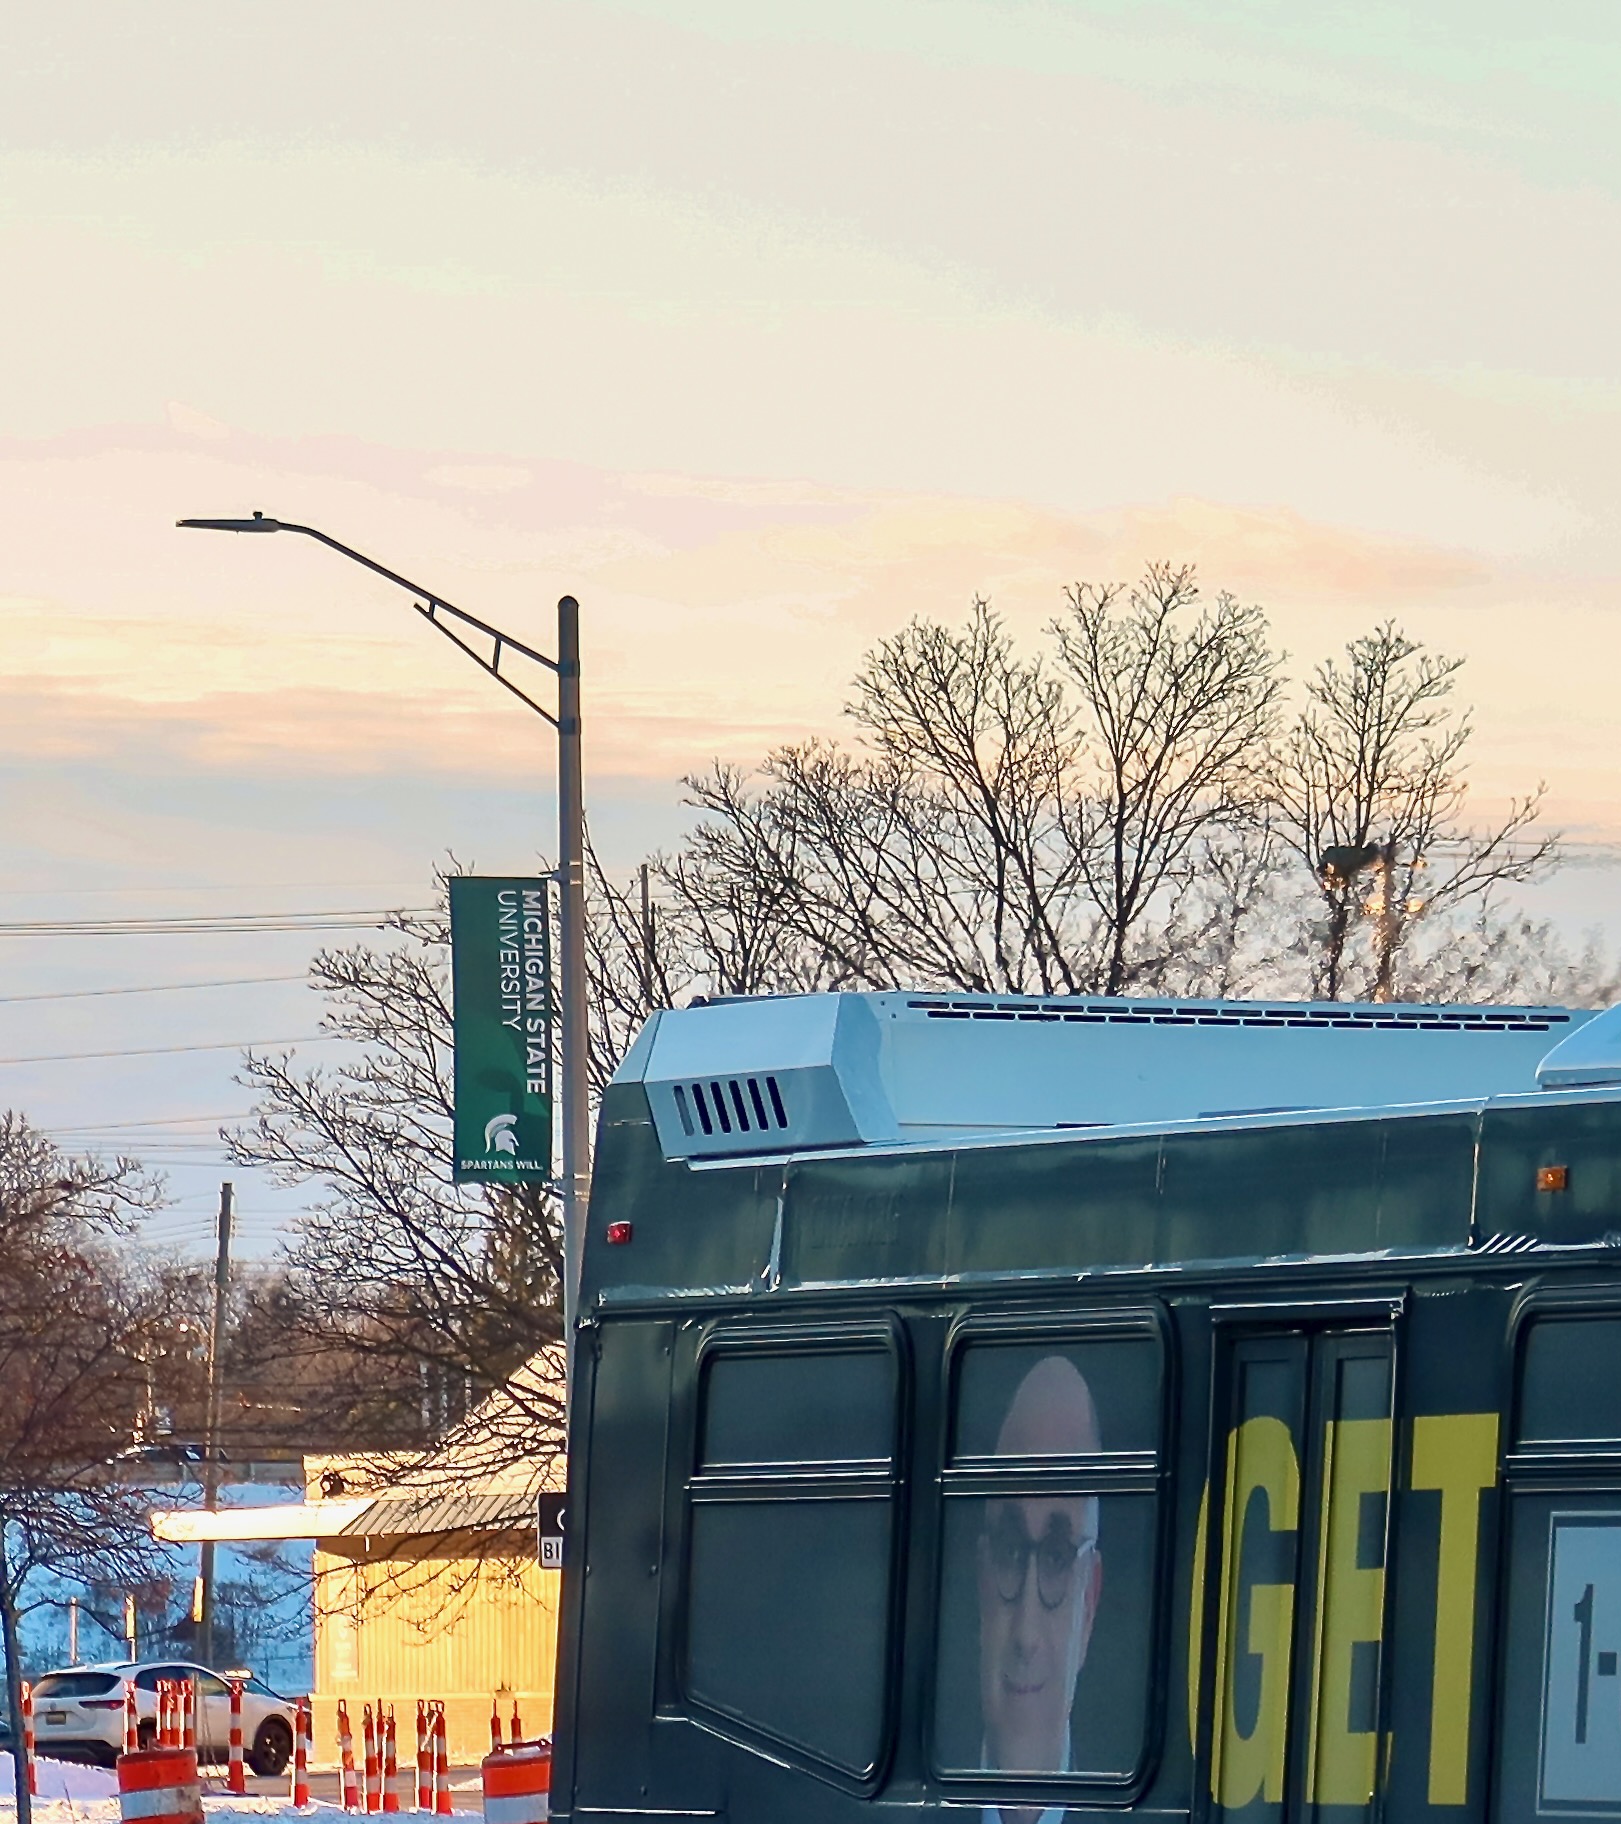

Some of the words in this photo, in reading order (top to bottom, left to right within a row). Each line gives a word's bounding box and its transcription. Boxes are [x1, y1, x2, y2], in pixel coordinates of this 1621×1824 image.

[497, 889, 522, 1032] UNIVERSITY
[521, 889, 545, 1011] MICHIGAN
[526, 1016, 547, 1094] STATE
[460, 1160, 514, 1171] SPARTANS
[1188, 1413, 1499, 1809] GET
